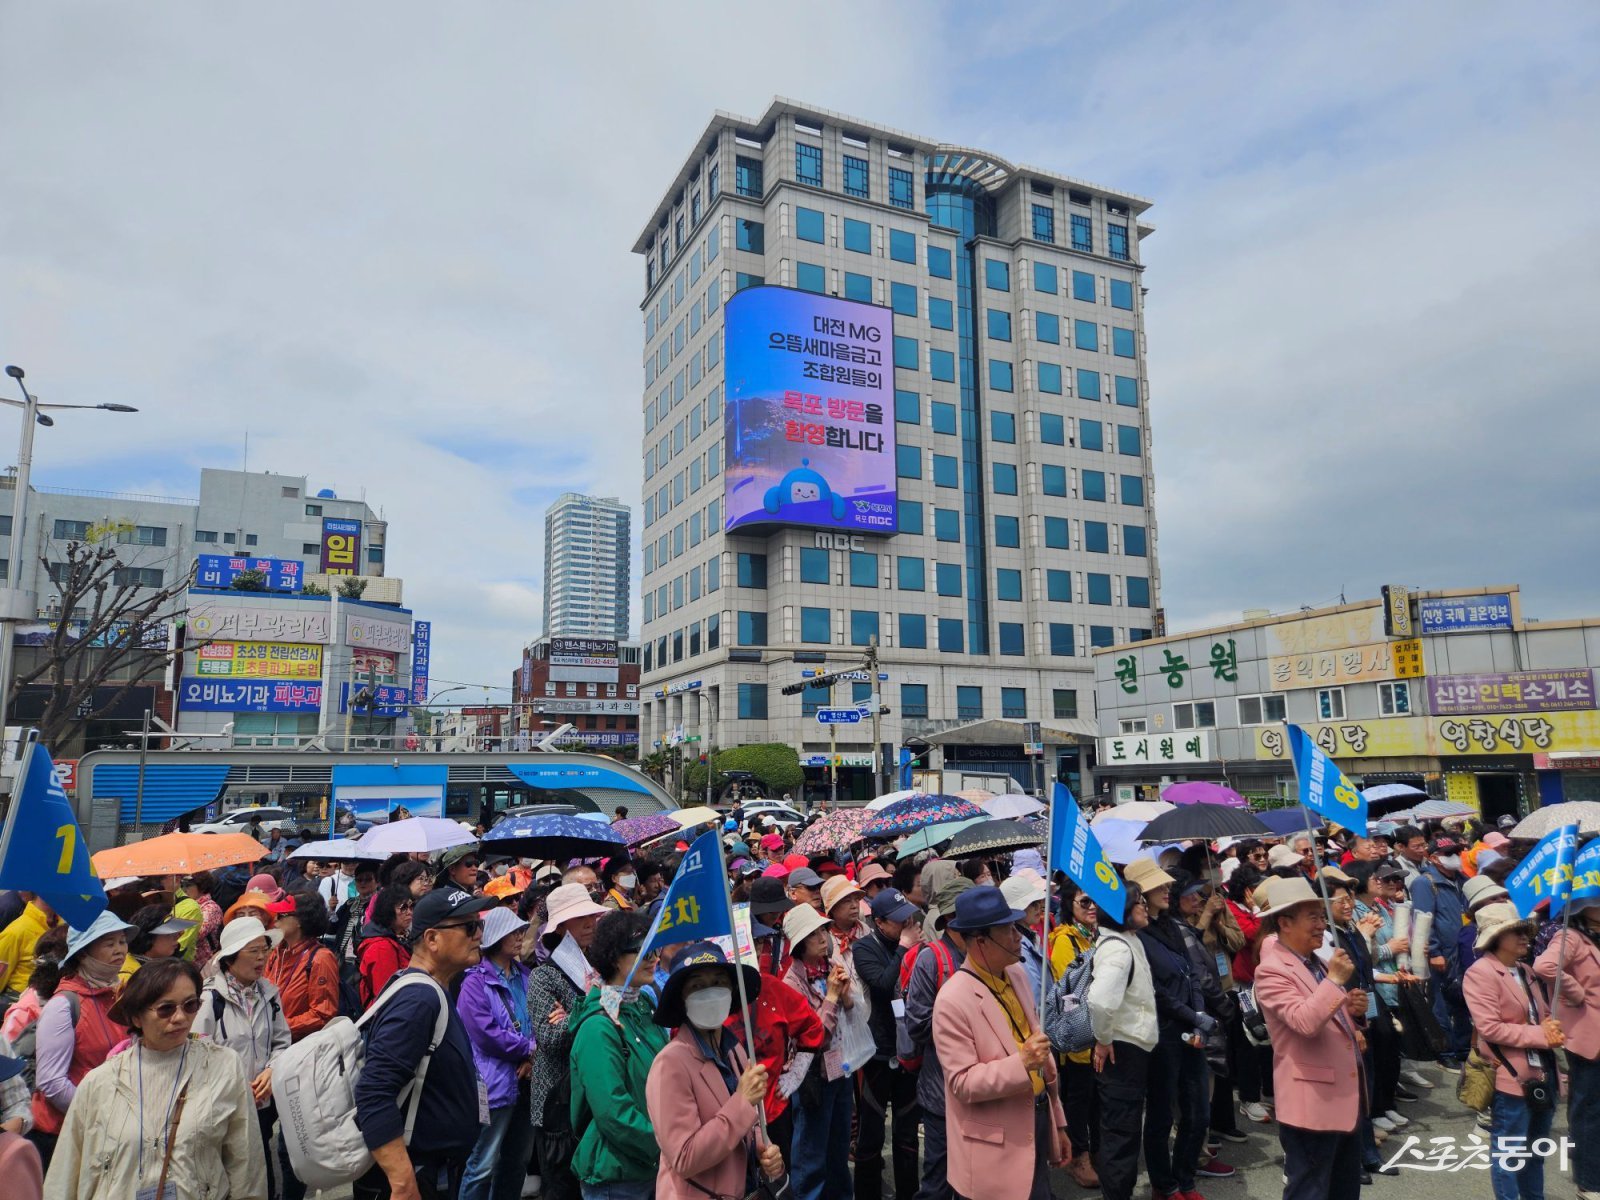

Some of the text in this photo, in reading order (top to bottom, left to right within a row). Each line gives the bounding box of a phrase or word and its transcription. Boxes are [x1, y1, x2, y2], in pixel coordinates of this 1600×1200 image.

[813, 316, 881, 342] 대전 MG
[768, 332, 882, 366] 으뜸새마을금고
[802, 361, 882, 390] 조합원들의
[783, 390, 883, 424] 목포 방문을
[785, 420, 884, 453] 환영합니다
[814, 531, 865, 551] MBC
[204, 571, 298, 588] 비과
[229, 558, 299, 576] 피부과
[218, 612, 328, 642] 피부관리실
[1469, 605, 1509, 621] 결혼정보
[270, 645, 319, 661] 전립선검사
[416, 623, 428, 665] 오비뇨기과
[587, 641, 616, 652] 비뇨기과
[1115, 638, 1239, 694] 권농원
[187, 684, 322, 706] 오비뇨기과 피부과
[1112, 736, 1202, 761] 도시원예
[1261, 725, 1369, 757] 영식당
[1440, 718, 1553, 751] 영창식당
[1309, 742, 1326, 808] 으뜸새마을
[289, 1099, 310, 1158] GEOGRAPHIC
[294, 1095, 310, 1143] NATIONAL
